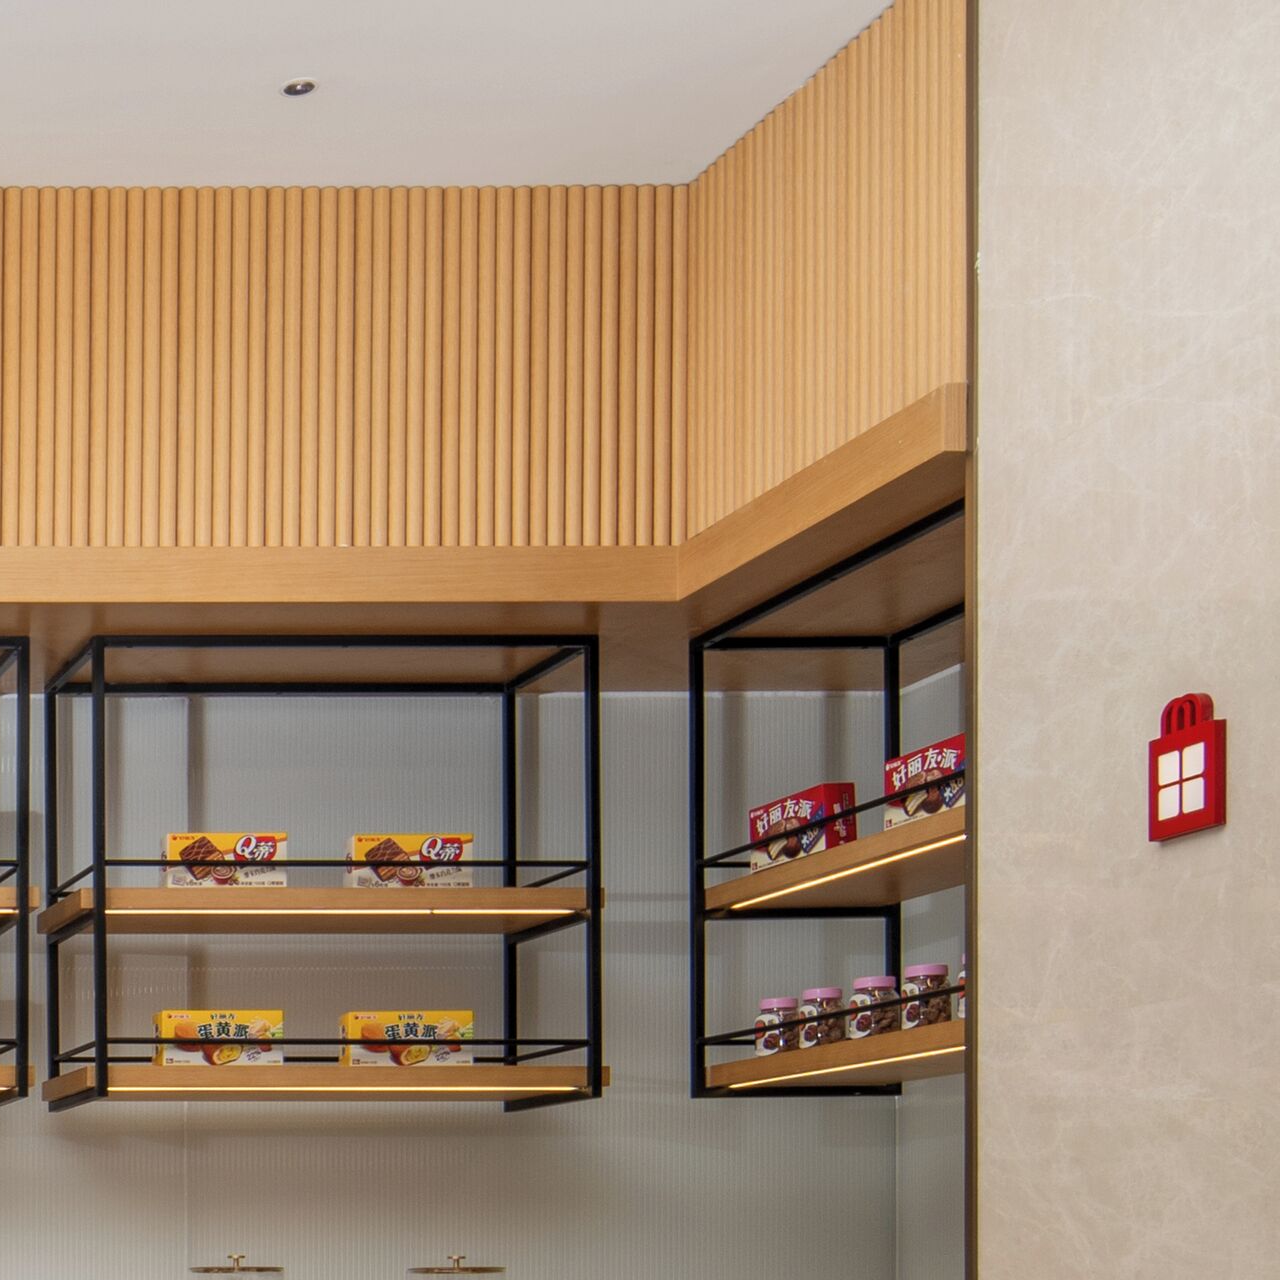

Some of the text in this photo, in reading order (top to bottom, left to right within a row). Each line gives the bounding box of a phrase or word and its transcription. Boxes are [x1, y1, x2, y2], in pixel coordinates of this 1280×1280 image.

[197, 1022, 250, 1040] 蛋黄派
[384, 1022, 438, 1040] 蛋黄派
